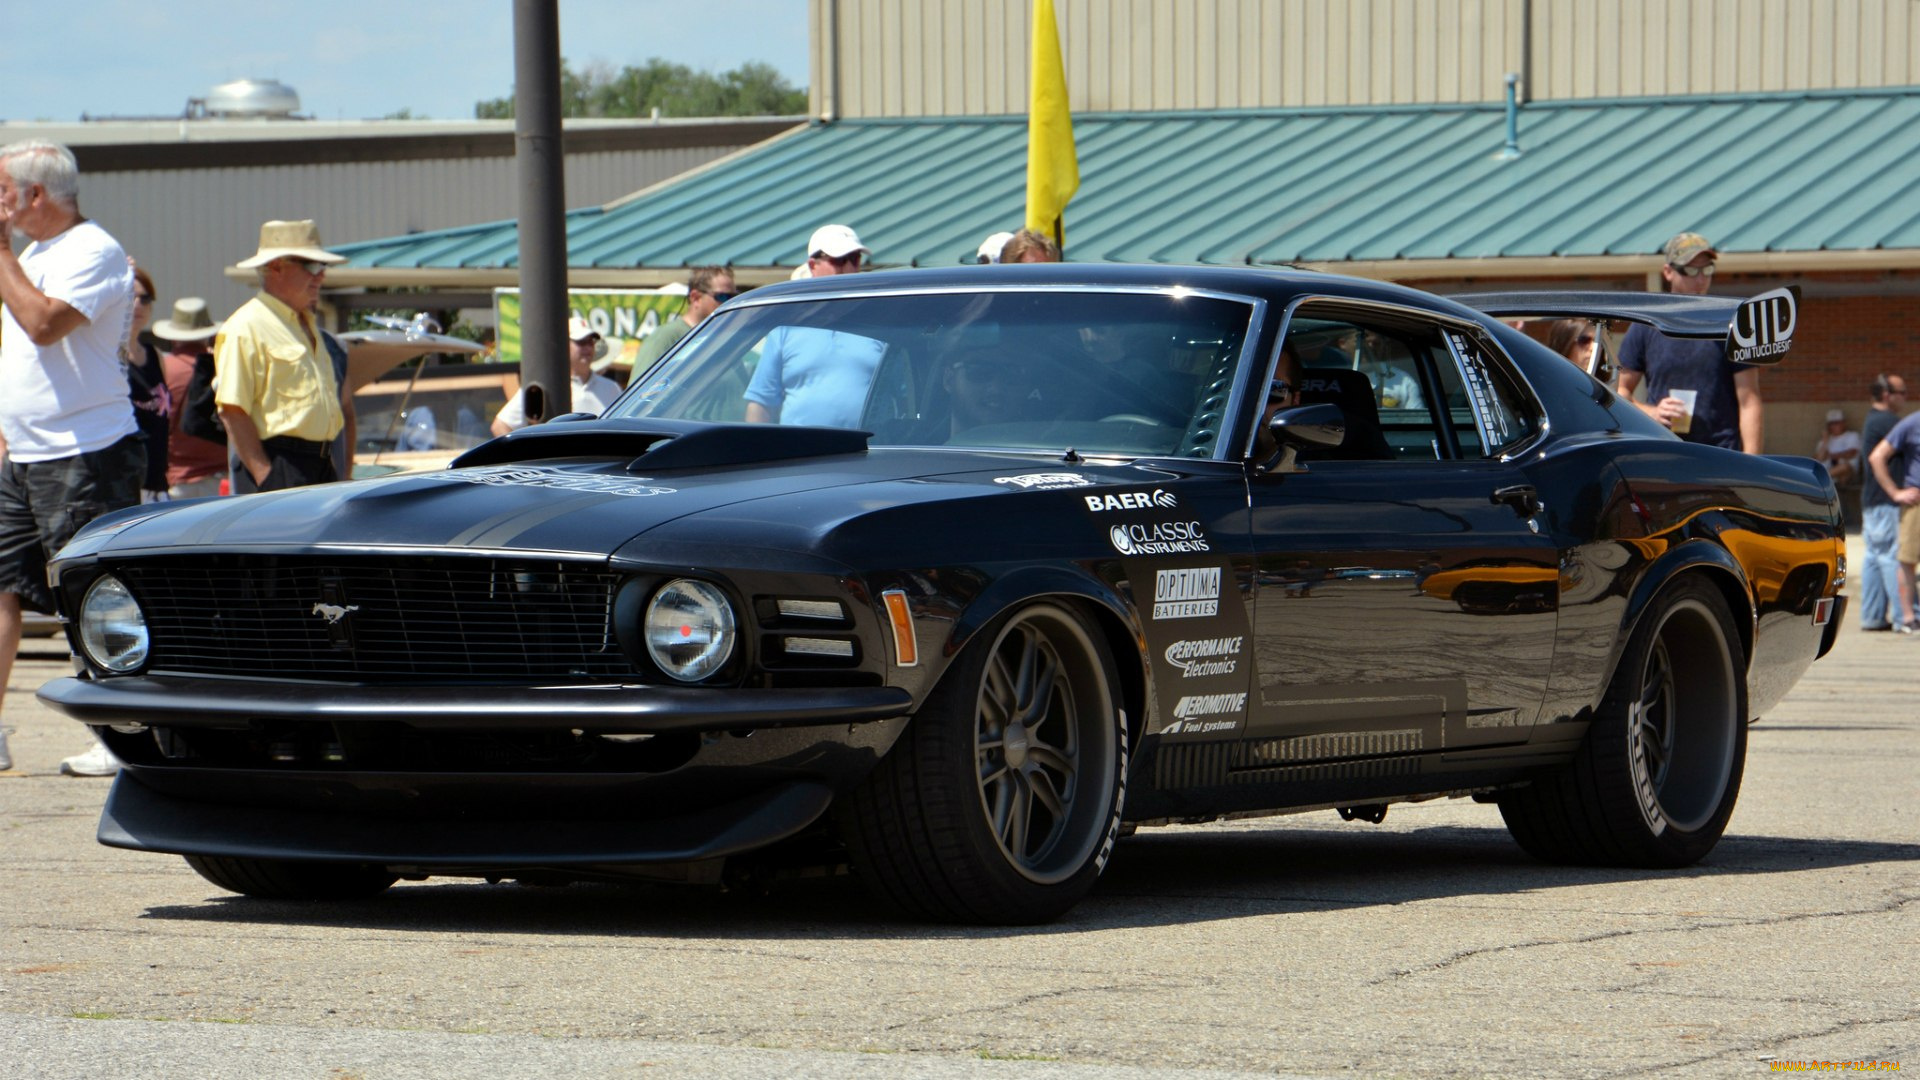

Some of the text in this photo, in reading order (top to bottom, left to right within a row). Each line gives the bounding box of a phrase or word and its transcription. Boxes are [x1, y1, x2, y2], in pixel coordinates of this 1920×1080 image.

[1733, 348, 1752, 362] DOM
[1752, 343, 1772, 358] TUCCI
[1084, 491, 1153, 512] BAER
[1129, 520, 1204, 543] CLASSIC
[1157, 571, 1219, 599] OPTIMA
[1155, 602, 1217, 618] BATTERIES
[1168, 636, 1243, 660] PERFORMANCE
[1182, 656, 1237, 679] Electronics
